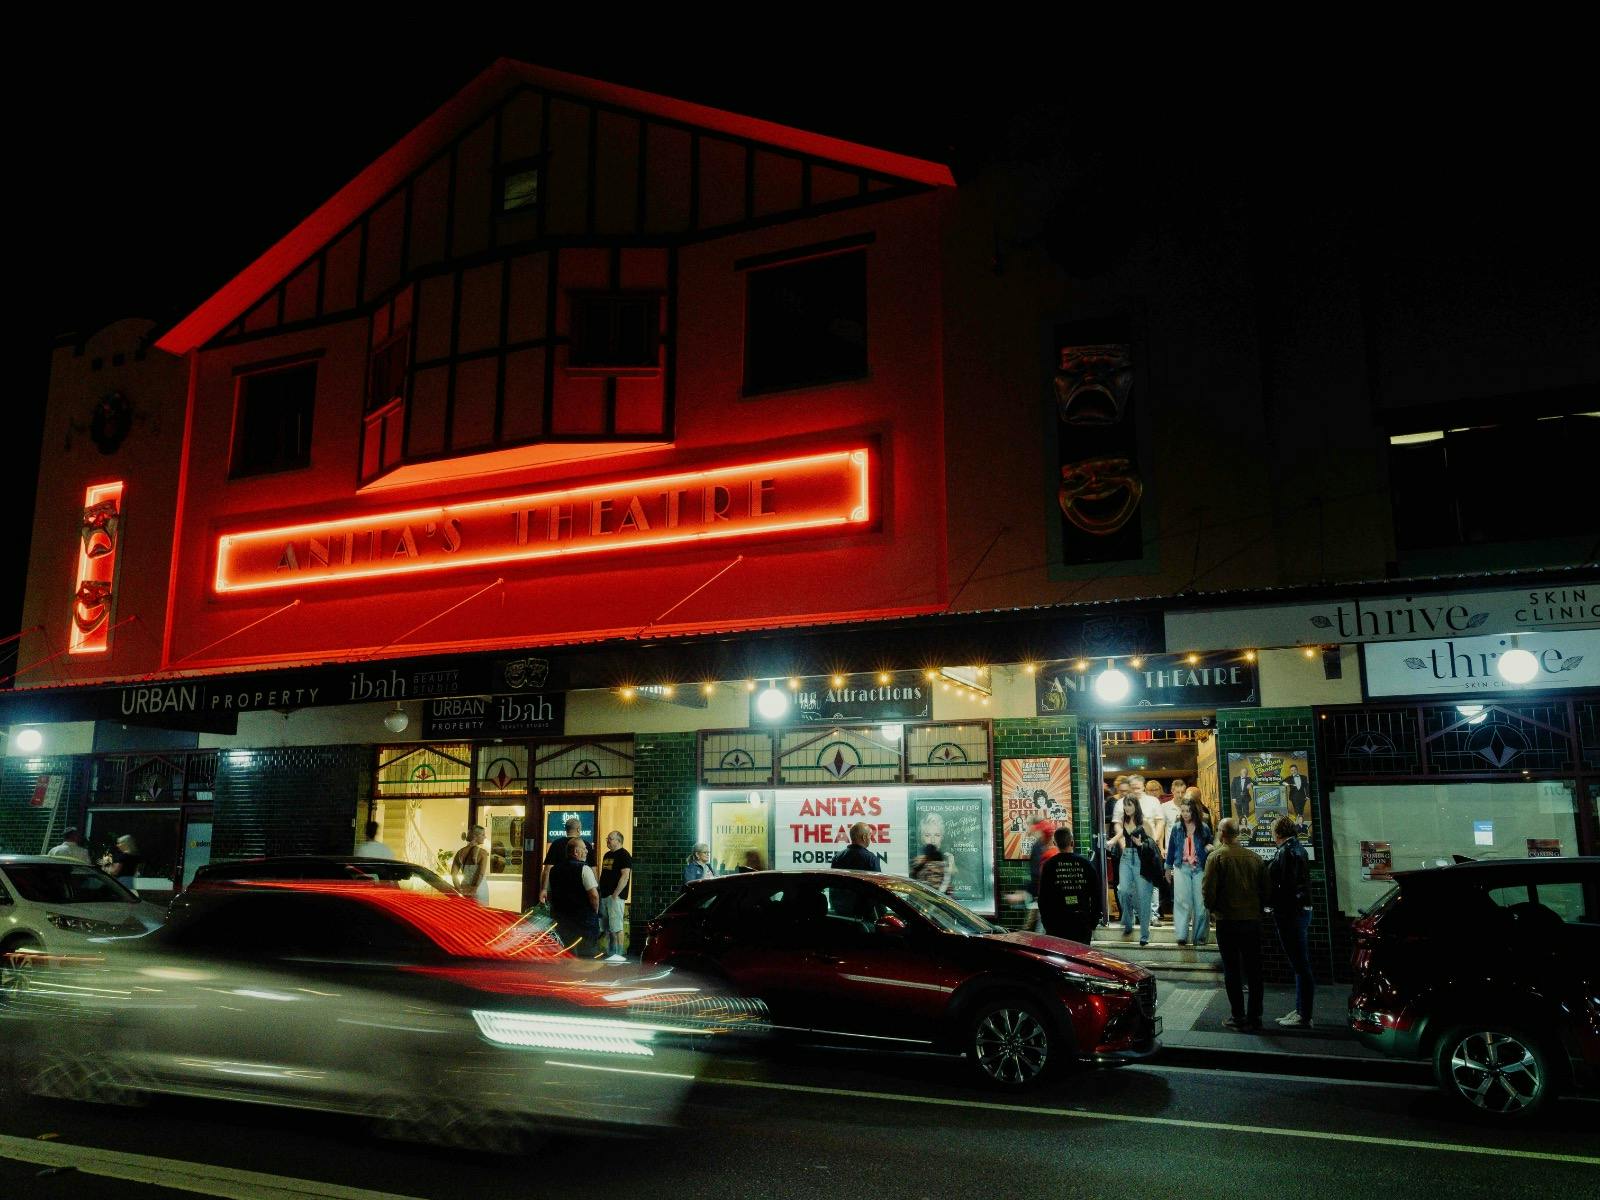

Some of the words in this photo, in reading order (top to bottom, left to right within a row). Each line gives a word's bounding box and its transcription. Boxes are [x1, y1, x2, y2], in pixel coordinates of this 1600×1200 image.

[272, 518, 462, 575] ANITA'S
[510, 477, 776, 546] THEATRE
[1529, 589, 1587, 605] SKIN
[1334, 596, 1469, 638] thrive
[1427, 641, 1564, 680] thre
[351, 669, 407, 699] ibah
[1142, 666, 1242, 689] THEATRE
[121, 686, 197, 715] URBAN
[211, 688, 320, 709] PROPERTY
[826, 685, 922, 704] Attractions
[432, 699, 485, 717] URBAN
[499, 695, 554, 722] ibah
[432, 721, 484, 731] PROPERTY
[799, 796, 882, 817] ANITA'S
[1008, 798, 1033, 810] BIG
